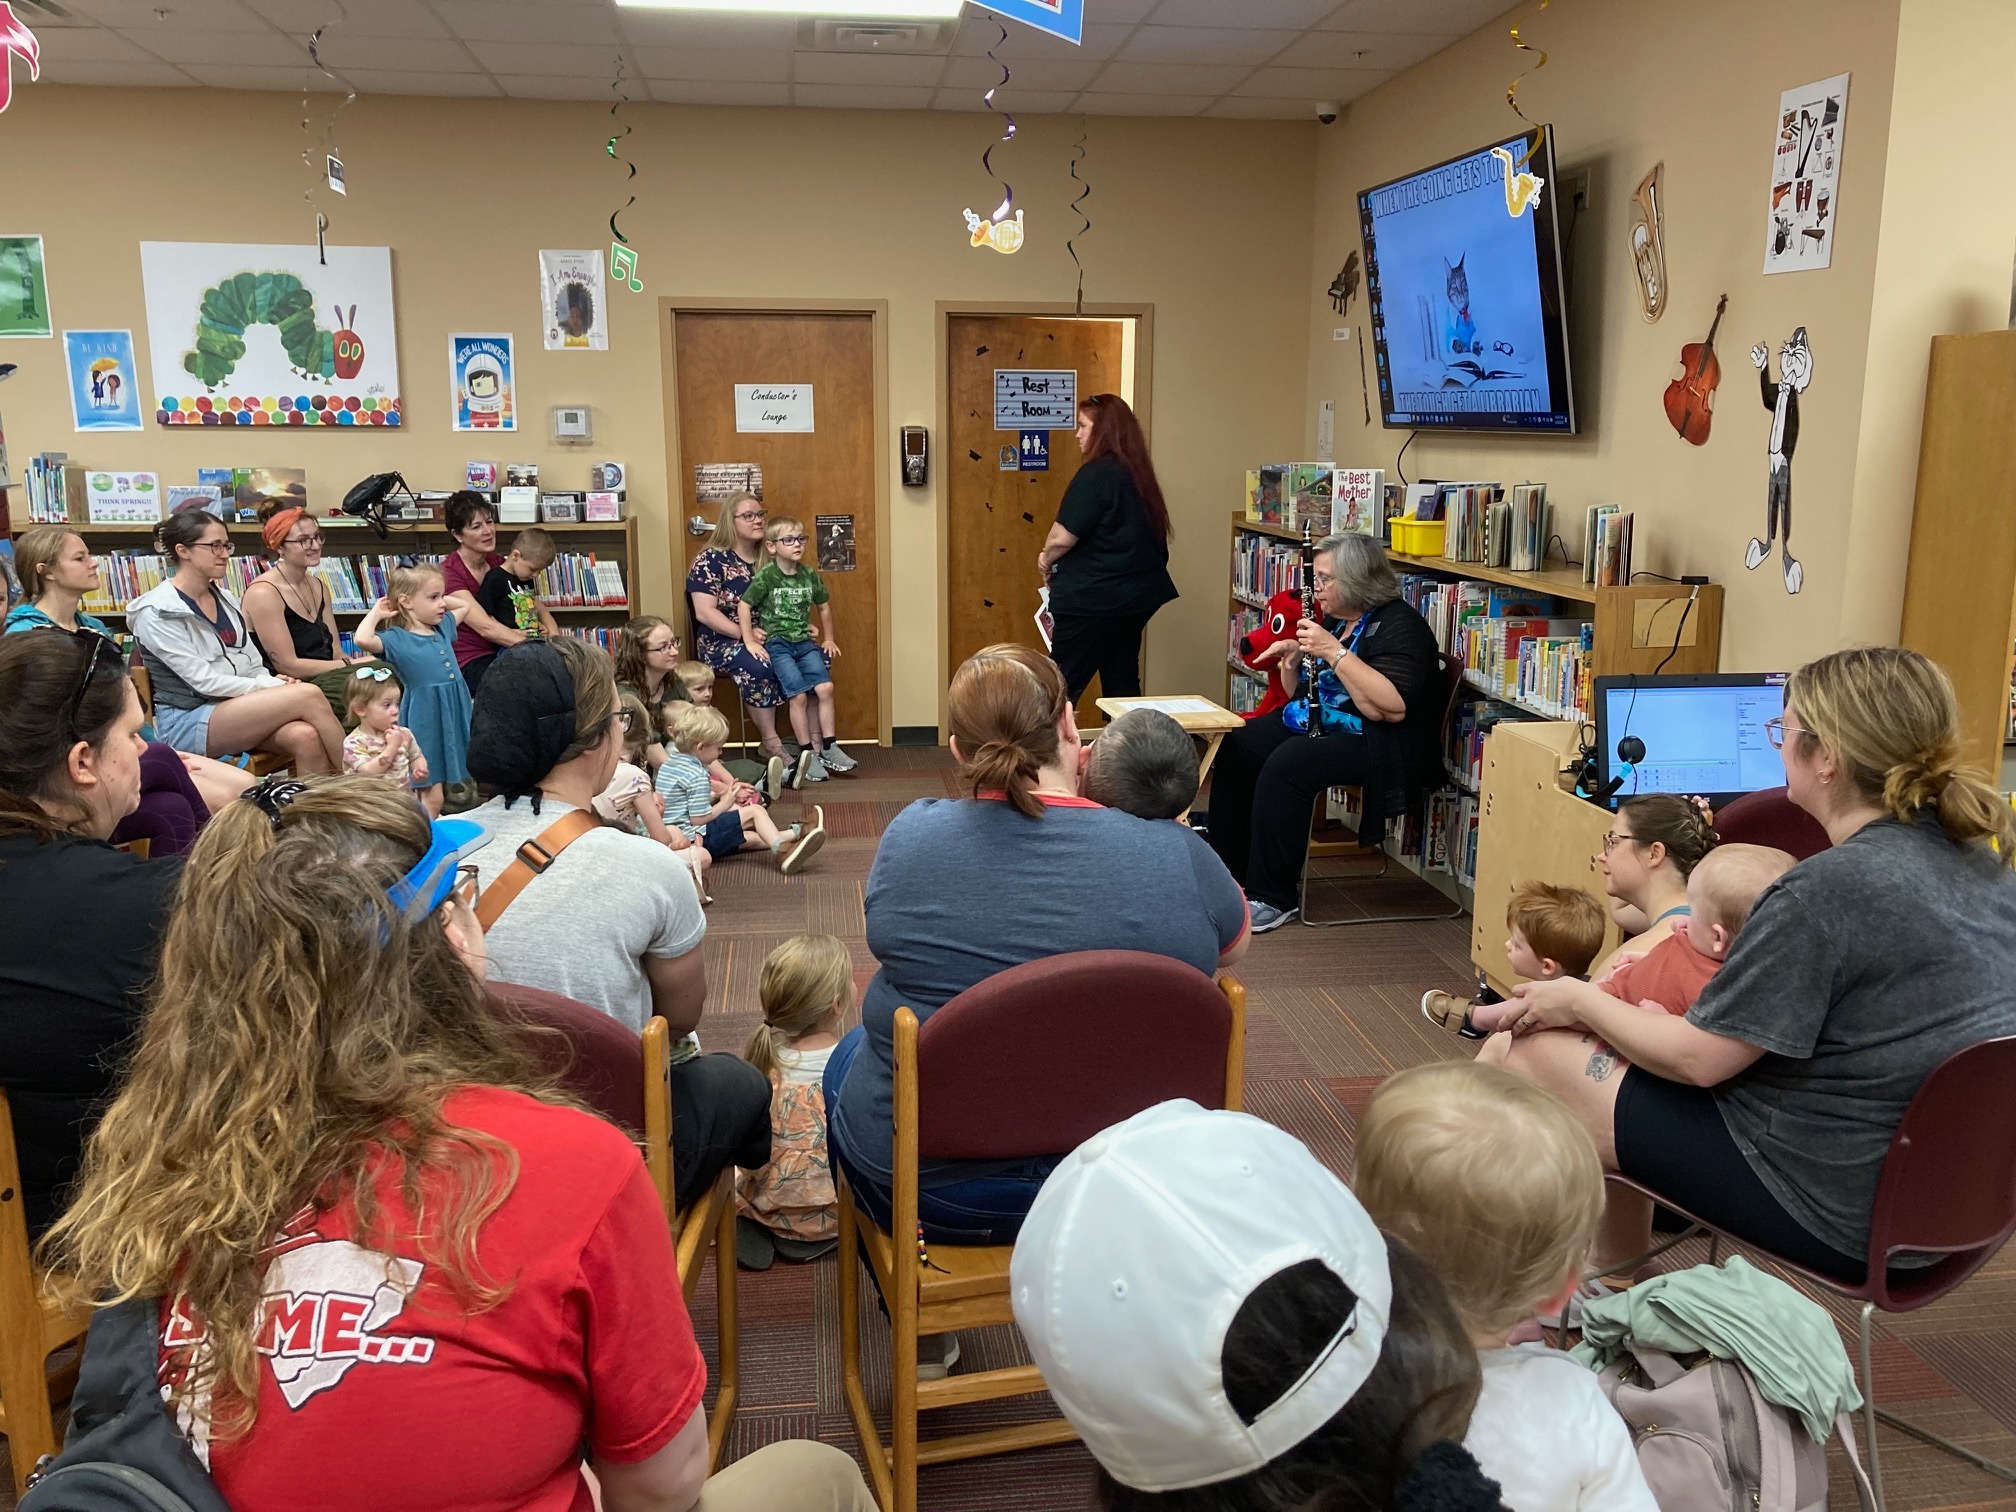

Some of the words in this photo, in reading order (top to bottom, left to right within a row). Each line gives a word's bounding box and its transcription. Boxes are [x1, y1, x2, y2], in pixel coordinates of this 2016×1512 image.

[1373, 186, 1401, 219] WHEN
[1399, 179, 1420, 211] THE
[1420, 169, 1452, 204] GOING
[1453, 158, 1481, 194] GETS
[557, 269, 571, 281] Am
[81, 343, 92, 353] BE
[97, 343, 118, 353] KIND
[481, 341, 510, 365] WONDERS
[1022, 377, 1050, 394] Rest
[751, 388, 798, 401] Conductor's
[1479, 388, 1541, 412] LIBRARIAN
[761, 409, 787, 425] Lounge
[1349, 472, 1371, 485] Best
[1338, 485, 1371, 502] Mother
